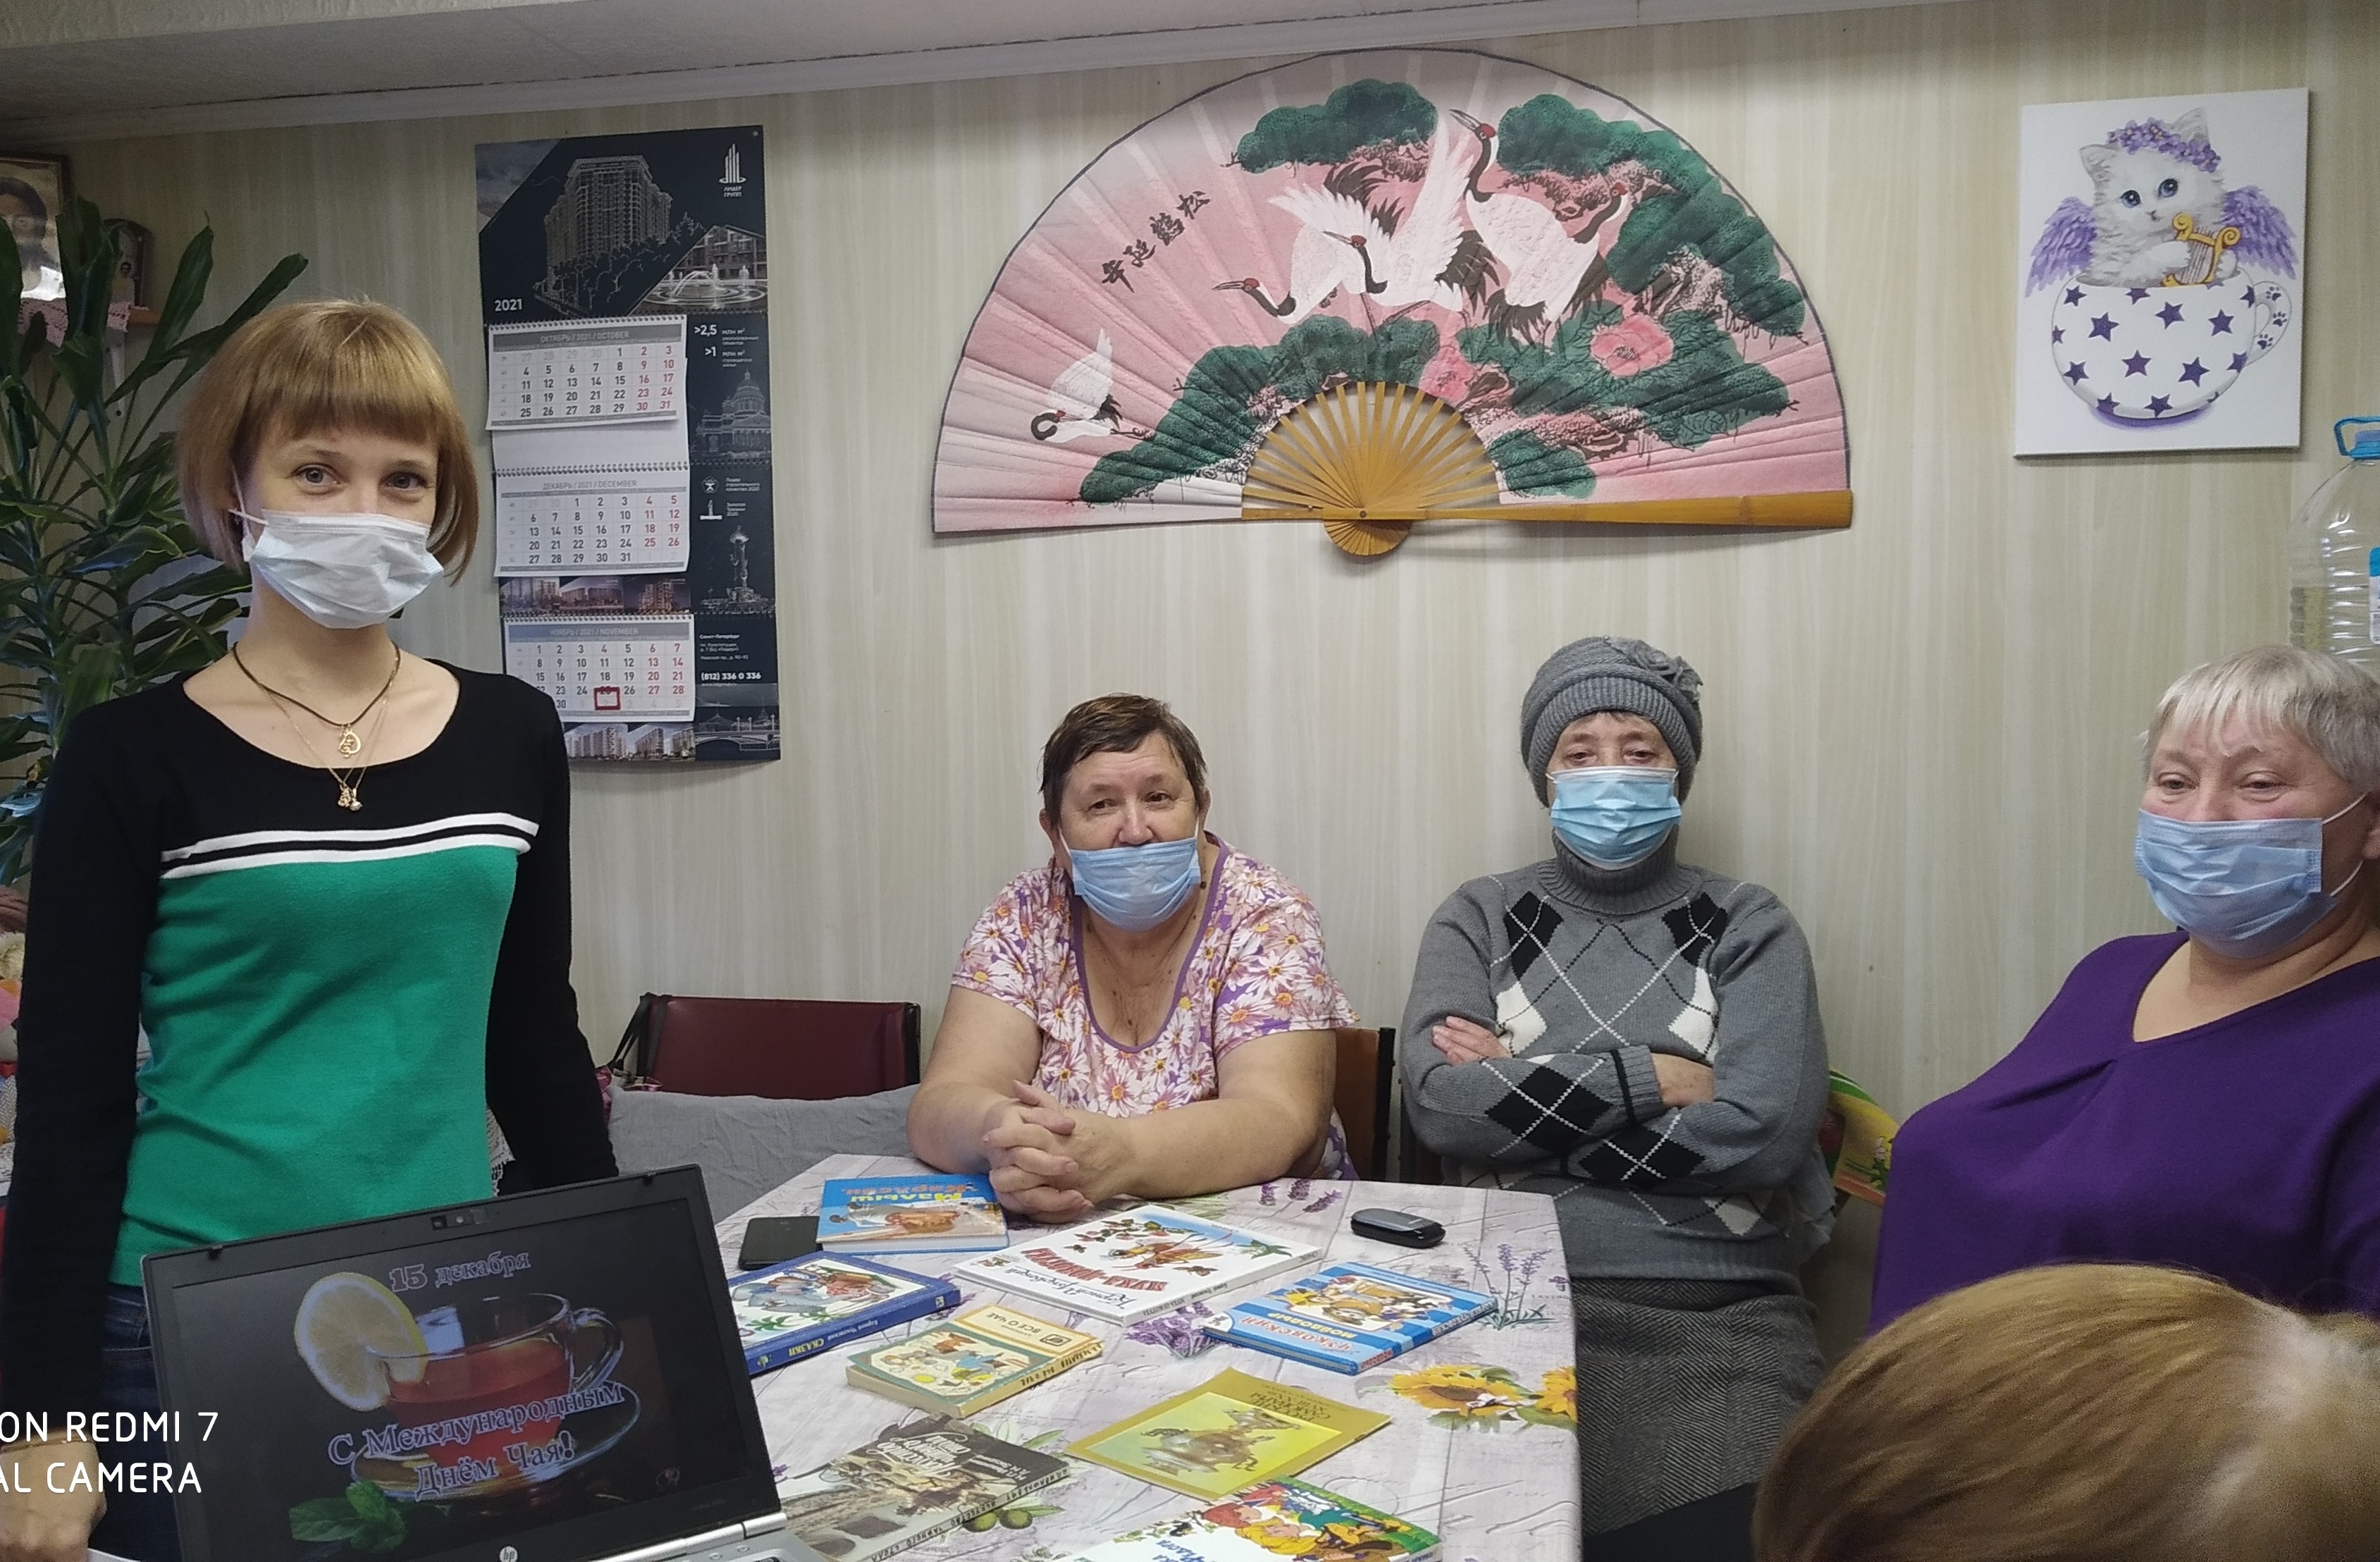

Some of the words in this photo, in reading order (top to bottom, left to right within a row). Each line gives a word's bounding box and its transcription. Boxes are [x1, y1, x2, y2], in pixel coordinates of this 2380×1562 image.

[495, 299, 523, 312] 2021
[694, 324, 717, 337] >2,5
[617, 348, 622, 357] 1
[641, 347, 647, 355] 2
[705, 346, 716, 357] >1
[545, 365, 551, 374] 5
[617, 362, 623, 371] 8
[641, 361, 647, 369] 9
[664, 359, 674, 369] 10
[522, 381, 530, 389] 11
[544, 379, 554, 388] 12
[615, 376, 626, 385] 15
[640, 375, 649, 383] 16
[664, 374, 674, 382] 17
[522, 395, 531, 403] 18
[544, 393, 553, 402] 19
[591, 391, 600, 400] 21
[615, 390, 625, 399] 22
[638, 389, 649, 398] 23
[661, 388, 672, 396] 24
[521, 409, 531, 417] 25
[543, 407, 553, 416] 26
[567, 406, 577, 414] 27
[590, 405, 601, 414] 28
[637, 402, 648, 411] 30
[660, 400, 670, 409] 31
[543, 482, 572, 491] ДЕКАБРЬ
[575, 498, 579, 507] 1
[598, 498, 603, 506] 2
[622, 497, 627, 505] 3
[646, 496, 653, 505] 4
[672, 496, 677, 504] 5
[531, 514, 536, 522] 6
[553, 513, 558, 522] 7
[575, 512, 581, 521] 8
[598, 512, 603, 520] 9
[620, 511, 631, 519] 10
[670, 510, 679, 518] 12
[574, 526, 584, 534] 15
[670, 524, 679, 532] 19
[529, 541, 540, 550] 20
[551, 541, 561, 549] 21
[573, 540, 584, 548] 22
[645, 539, 655, 547] 25
[529, 555, 540, 564] 27
[574, 554, 584, 562] 29
[596, 553, 608, 562] 30
[621, 553, 631, 561] 31
[537, 644, 541, 653] 1
[602, 644, 607, 653] 4
[626, 644, 631, 653] 5
[537, 659, 542, 668] 8
[600, 658, 609, 667] 11
[624, 658, 634, 667] 12
[673, 658, 684, 666] 14
[537, 672, 545, 681] 15
[557, 672, 565, 681] 16
[578, 672, 586, 681] 17
[624, 672, 634, 680] 19
[648, 672, 660, 680] 20
[701, 672, 720, 681] (812)
[624, 686, 635, 694] 26
[557, 699, 566, 708] 30
[850, 1191, 963, 1203] Малыш
[389, 1264, 428, 1292] 15
[436, 1250, 531, 1289] декабря
[987, 1312, 1007, 1322] ЧАЕ
[1019, 1324, 1042, 1334] ВСЕ
[1240, 1316, 1352, 1351] ЧУКОВСКИЙ
[789, 1339, 824, 1357] СКАЗКИ
[328, 1437, 355, 1465] С
[363, 1382, 625, 1460] Международным
[414, 1456, 498, 1501] Днём
[502, 1430, 576, 1472] Чая!
